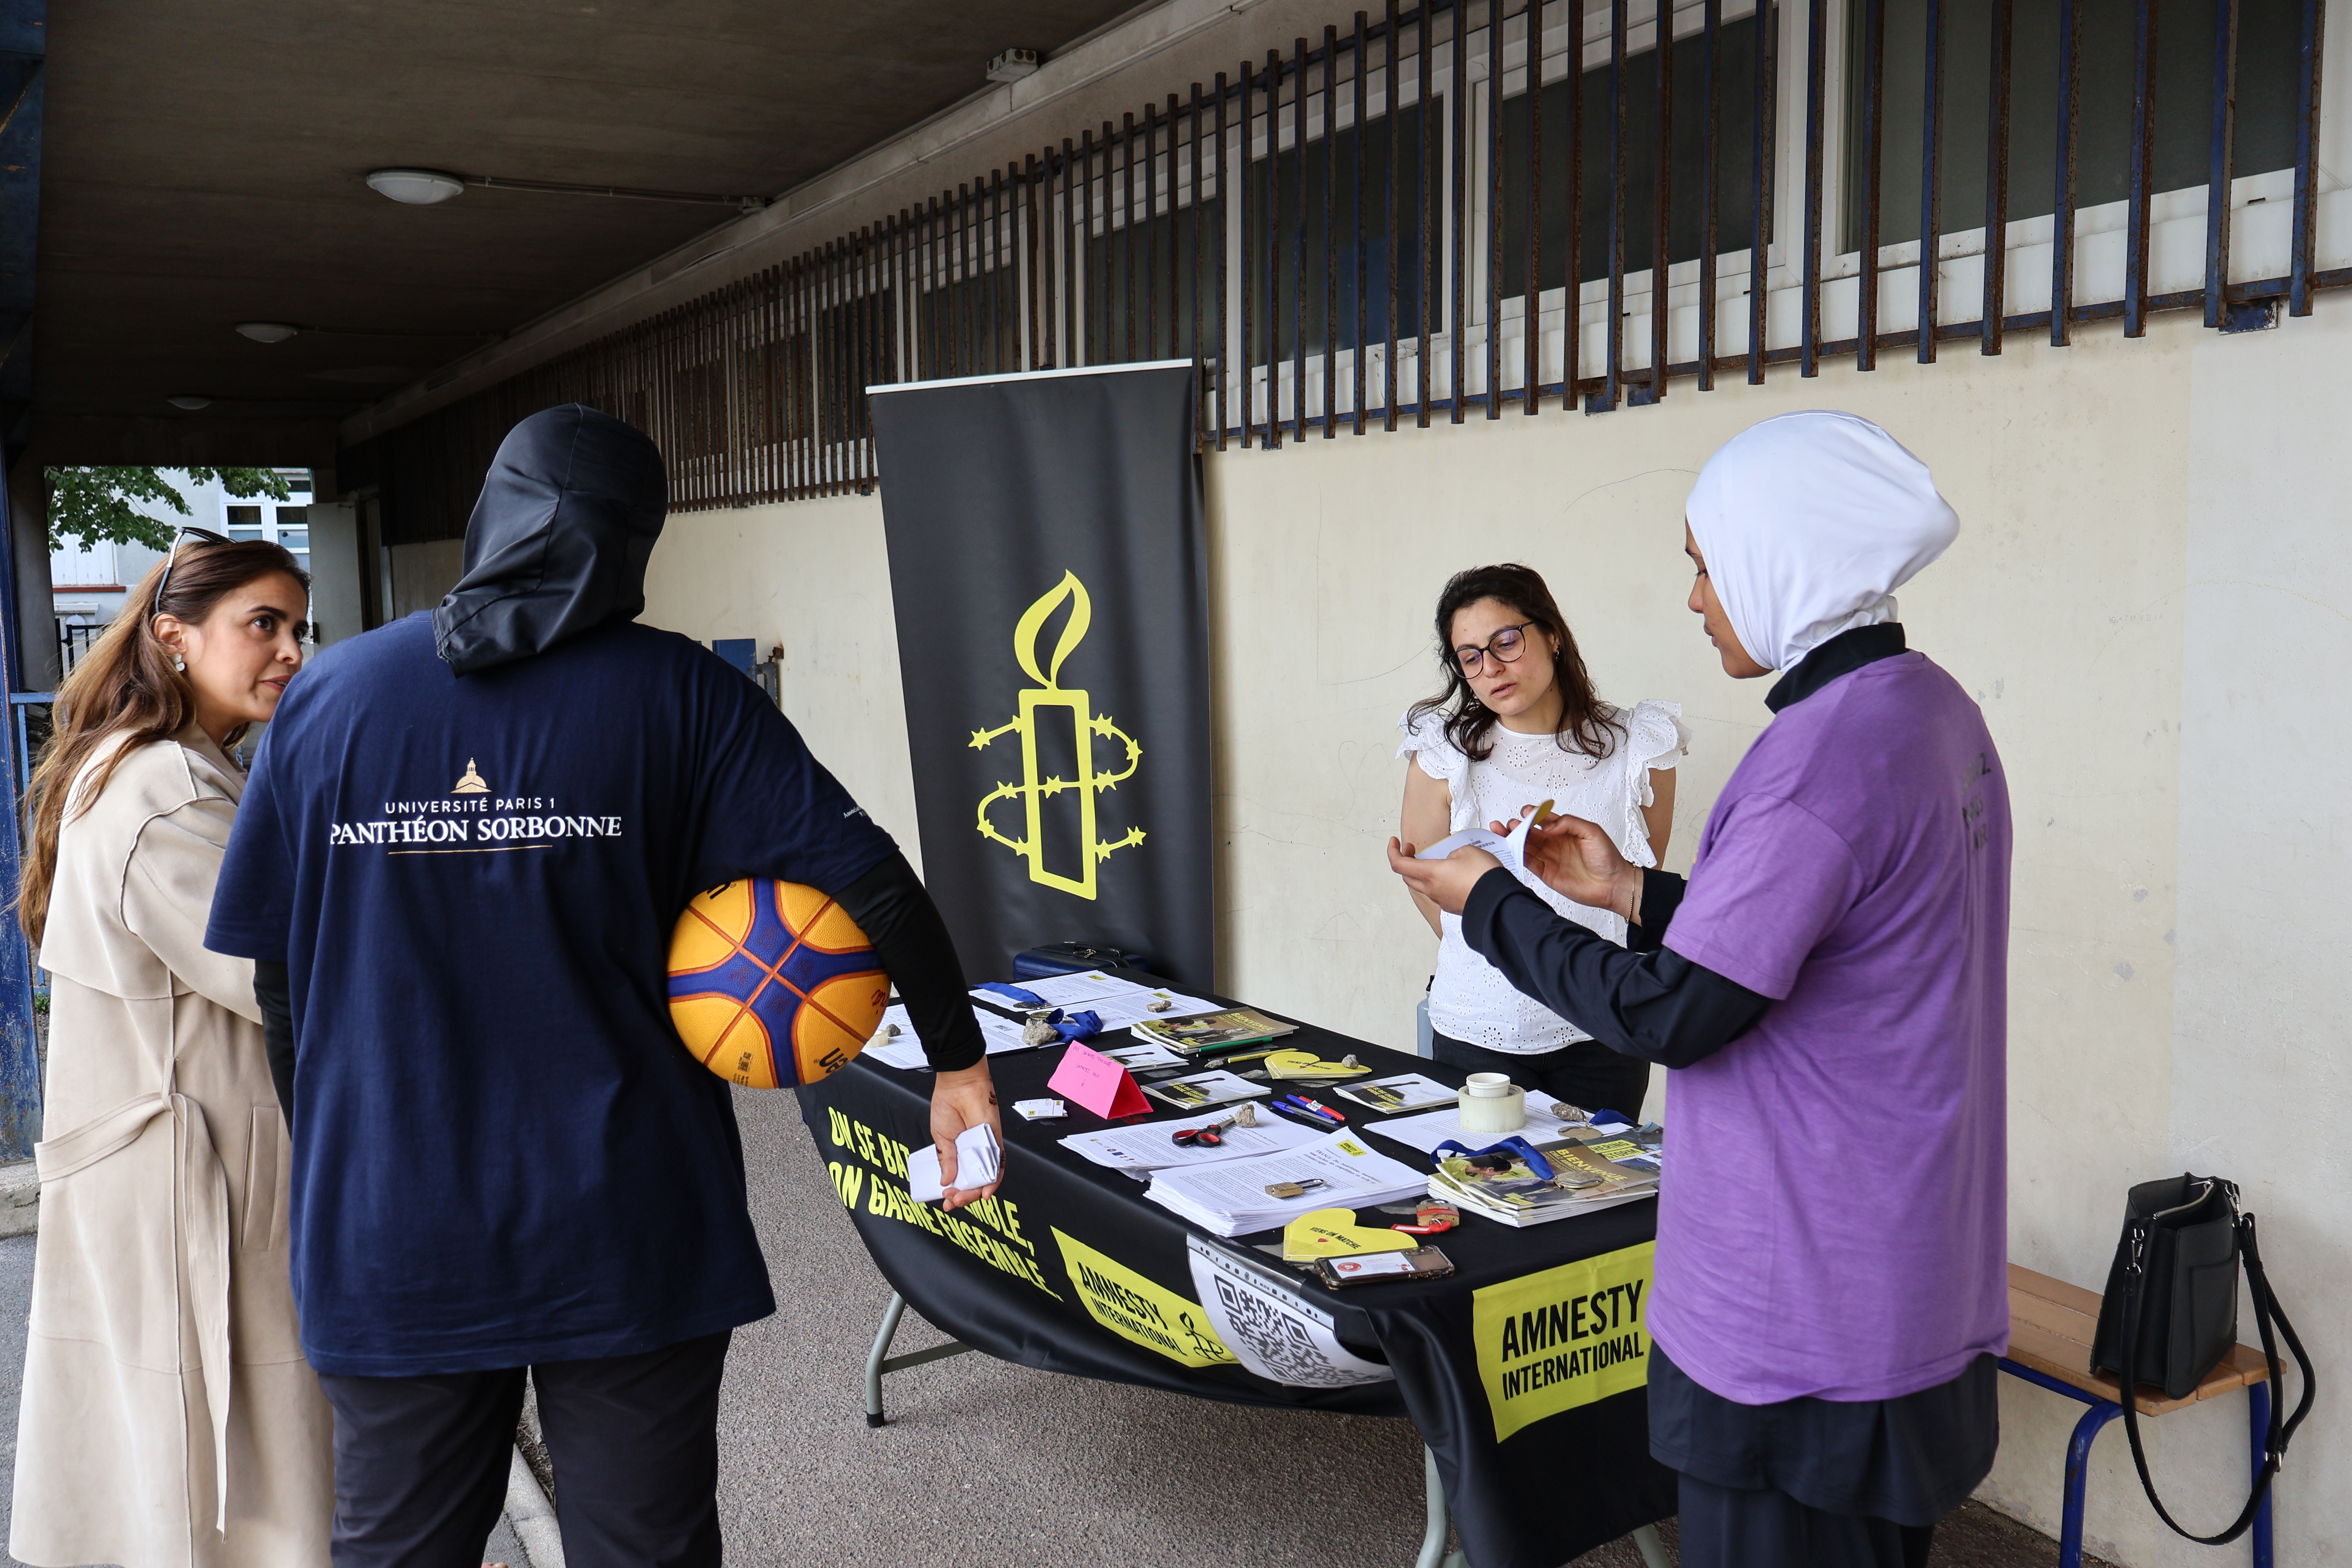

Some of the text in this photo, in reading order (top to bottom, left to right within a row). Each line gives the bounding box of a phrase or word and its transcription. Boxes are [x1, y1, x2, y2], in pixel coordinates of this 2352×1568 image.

[385, 798, 555, 814] UNIVERSITÉ PARIS 1
[330, 816, 622, 845] PANTHÉON SORBONNE
[1230, 1013, 1276, 1031] BIENVENUE
[828, 1106, 856, 1153] ON
[854, 1120, 882, 1168] SE
[1343, 1142, 1357, 1151] AMNESTY
[1549, 1151, 1563, 1159] CHEZ
[1555, 1149, 1628, 1181] BIENVENUE
[829, 1161, 863, 1209] ON
[868, 1173, 944, 1237] GAGNE
[1335, 1235, 1361, 1249] MATCHE
[1077, 1261, 1169, 1331] AMNESTY
[1091, 1296, 1188, 1357] INTERNATIONAL
[1502, 1279, 1644, 1363] AMNESTY
[1502, 1332, 1644, 1401] INTERNATIONAL
